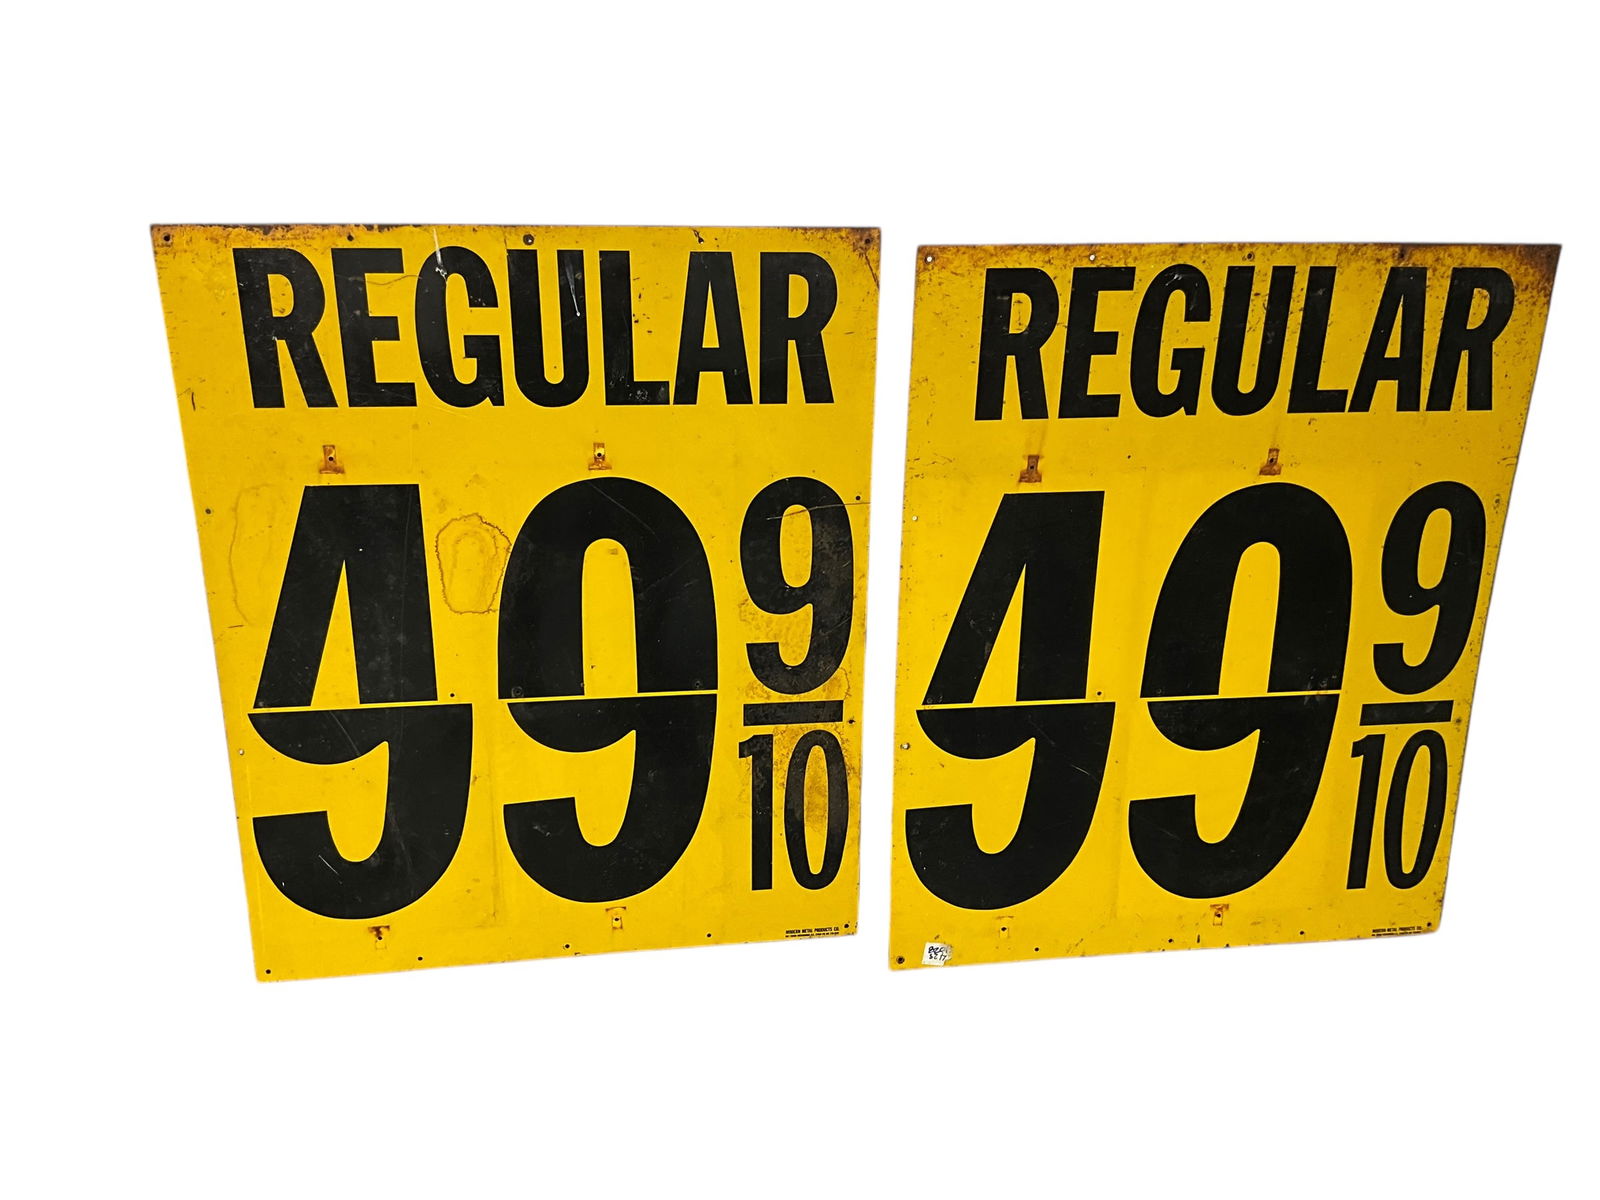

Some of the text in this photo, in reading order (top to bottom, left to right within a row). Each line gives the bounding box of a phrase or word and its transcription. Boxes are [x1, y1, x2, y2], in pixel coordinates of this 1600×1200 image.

[233, 246, 837, 408] REGULAR
[975, 264, 1515, 420] REGULAR
[740, 477, 853, 694] 9
[1374, 481, 1485, 694] 9
[739, 730, 848, 890] 10
[1347, 730, 1447, 889] 10
